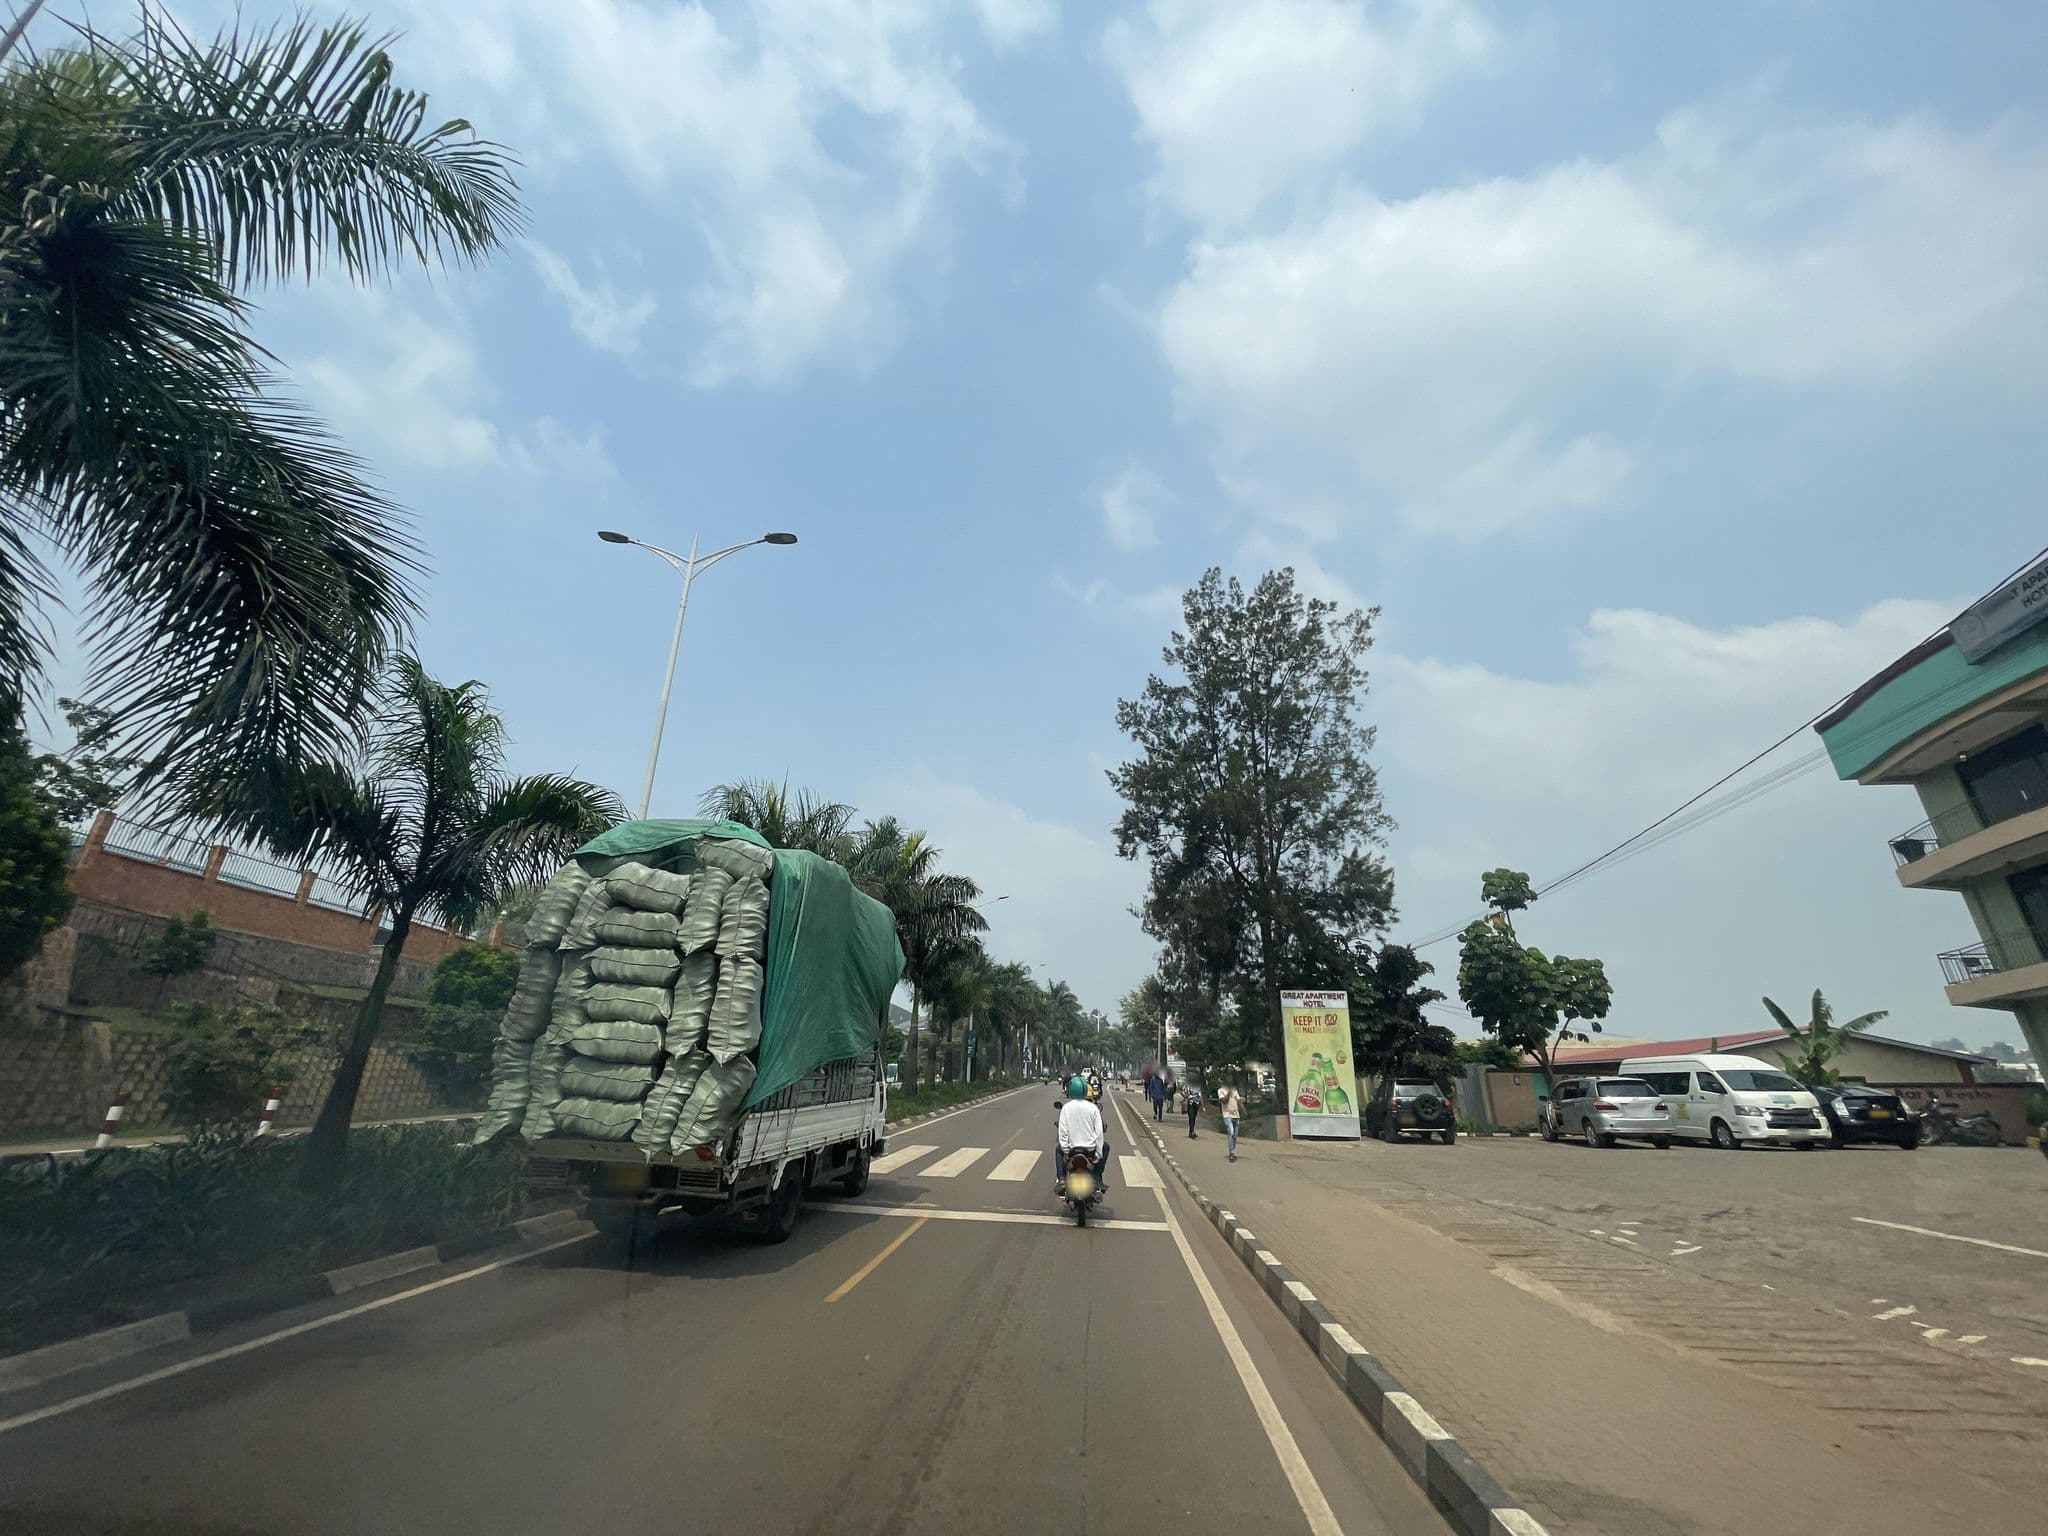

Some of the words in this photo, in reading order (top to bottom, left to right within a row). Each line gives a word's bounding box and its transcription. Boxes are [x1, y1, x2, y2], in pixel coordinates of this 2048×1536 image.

[1282, 992, 1304, 1000] GREAT
[1305, 992, 1345, 1000] APARTMENT
[1303, 1000, 1326, 1008] HOTEL
[1292, 1015, 1313, 1026] KEEP
[1314, 1015, 1322, 1026] IT
[1300, 1087, 1320, 1097] SKOL
